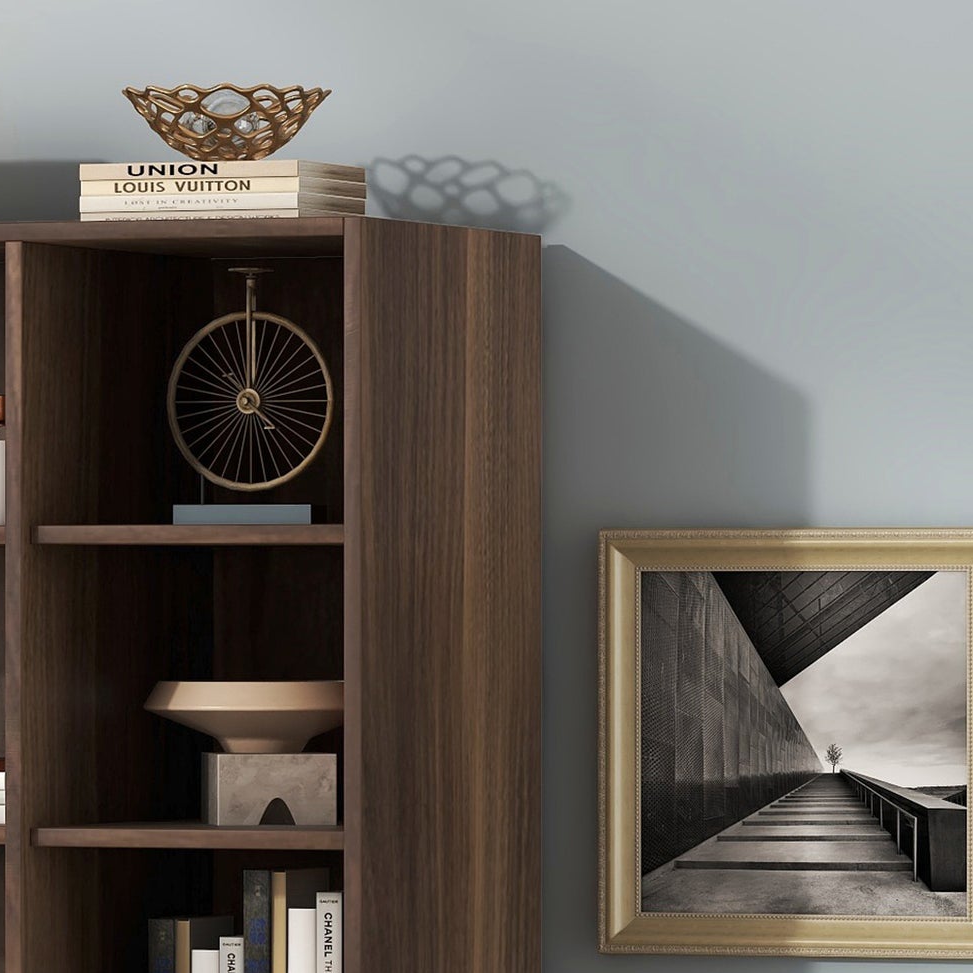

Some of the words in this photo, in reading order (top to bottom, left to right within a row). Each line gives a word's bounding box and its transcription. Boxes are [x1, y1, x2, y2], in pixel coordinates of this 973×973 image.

[127, 163, 219, 177] UNION
[114, 181, 166, 194] LOUIS
[175, 179, 251, 192] VUITTON
[324, 912, 333, 957] CHANEL
